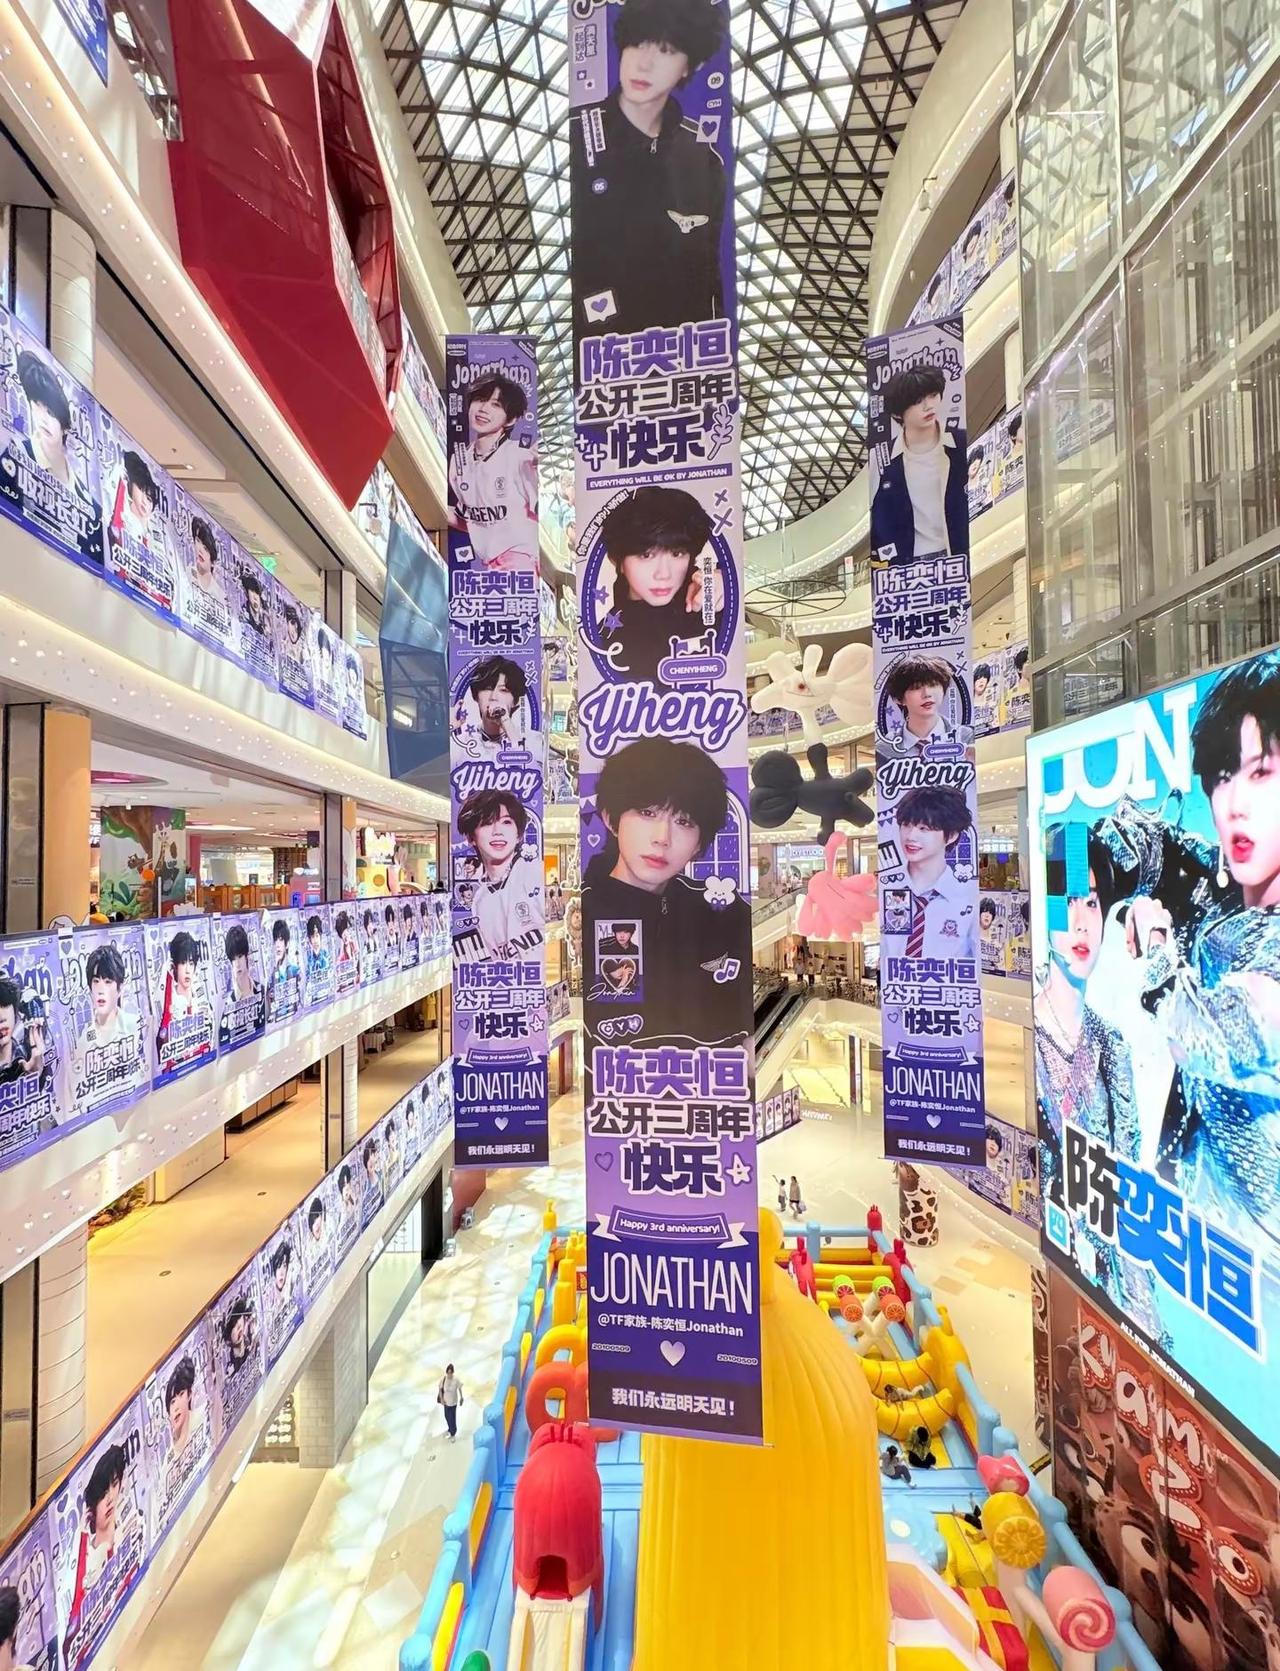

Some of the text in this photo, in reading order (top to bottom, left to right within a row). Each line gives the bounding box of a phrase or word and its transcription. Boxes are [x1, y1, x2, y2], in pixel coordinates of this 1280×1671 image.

[582, 320, 730, 382] 陈奕恒
[451, 357, 532, 389] Jonathan
[872, 346, 958, 391] Jonathan
[577, 372, 733, 420] 公开三周年
[610, 415, 705, 469] 快乐
[589, 467, 728, 488] EVERYTHING WILL BE OK BY JONATHAN
[453, 570, 536, 596] 陈奕恒
[877, 557, 966, 595] 陈奕恒
[450, 597, 540, 618] 公开三周年
[875, 585, 967, 615] 公开三周年
[469, 620, 523, 646] 快乐
[894, 609, 951, 641] 快乐
[669, 664, 718, 675] CHENYIHENG
[583, 683, 736, 751] Yiheng
[453, 764, 540, 800] Yiheng
[879, 759, 970, 795] Yiheng
[459, 961, 541, 988] 陈奕恒
[887, 958, 977, 983] 陈奕恒
[455, 989, 545, 1010] 公开三周年
[884, 985, 980, 1007] 公开三周年
[475, 1012, 529, 1040] 快乐
[904, 1008, 963, 1036] 快乐
[456, 1071, 545, 1101] JONATHAN
[595, 1047, 747, 1096] 陈奕恒
[885, 1066, 981, 1102] JONATHAN
[590, 1100, 751, 1138] 公开三周年
[624, 1141, 722, 1194] 快乐
[620, 1218, 721, 1234] Happy 3rd anniversary!
[1065, 1123, 1260, 1357] 陈奕恒
[590, 1252, 753, 1315] JONATHAN
[597, 1313, 744, 1337] @TF家族-陈奕恒Jonathan
[1120, 1322, 1196, 1399] ALL FOR JONATHAN
